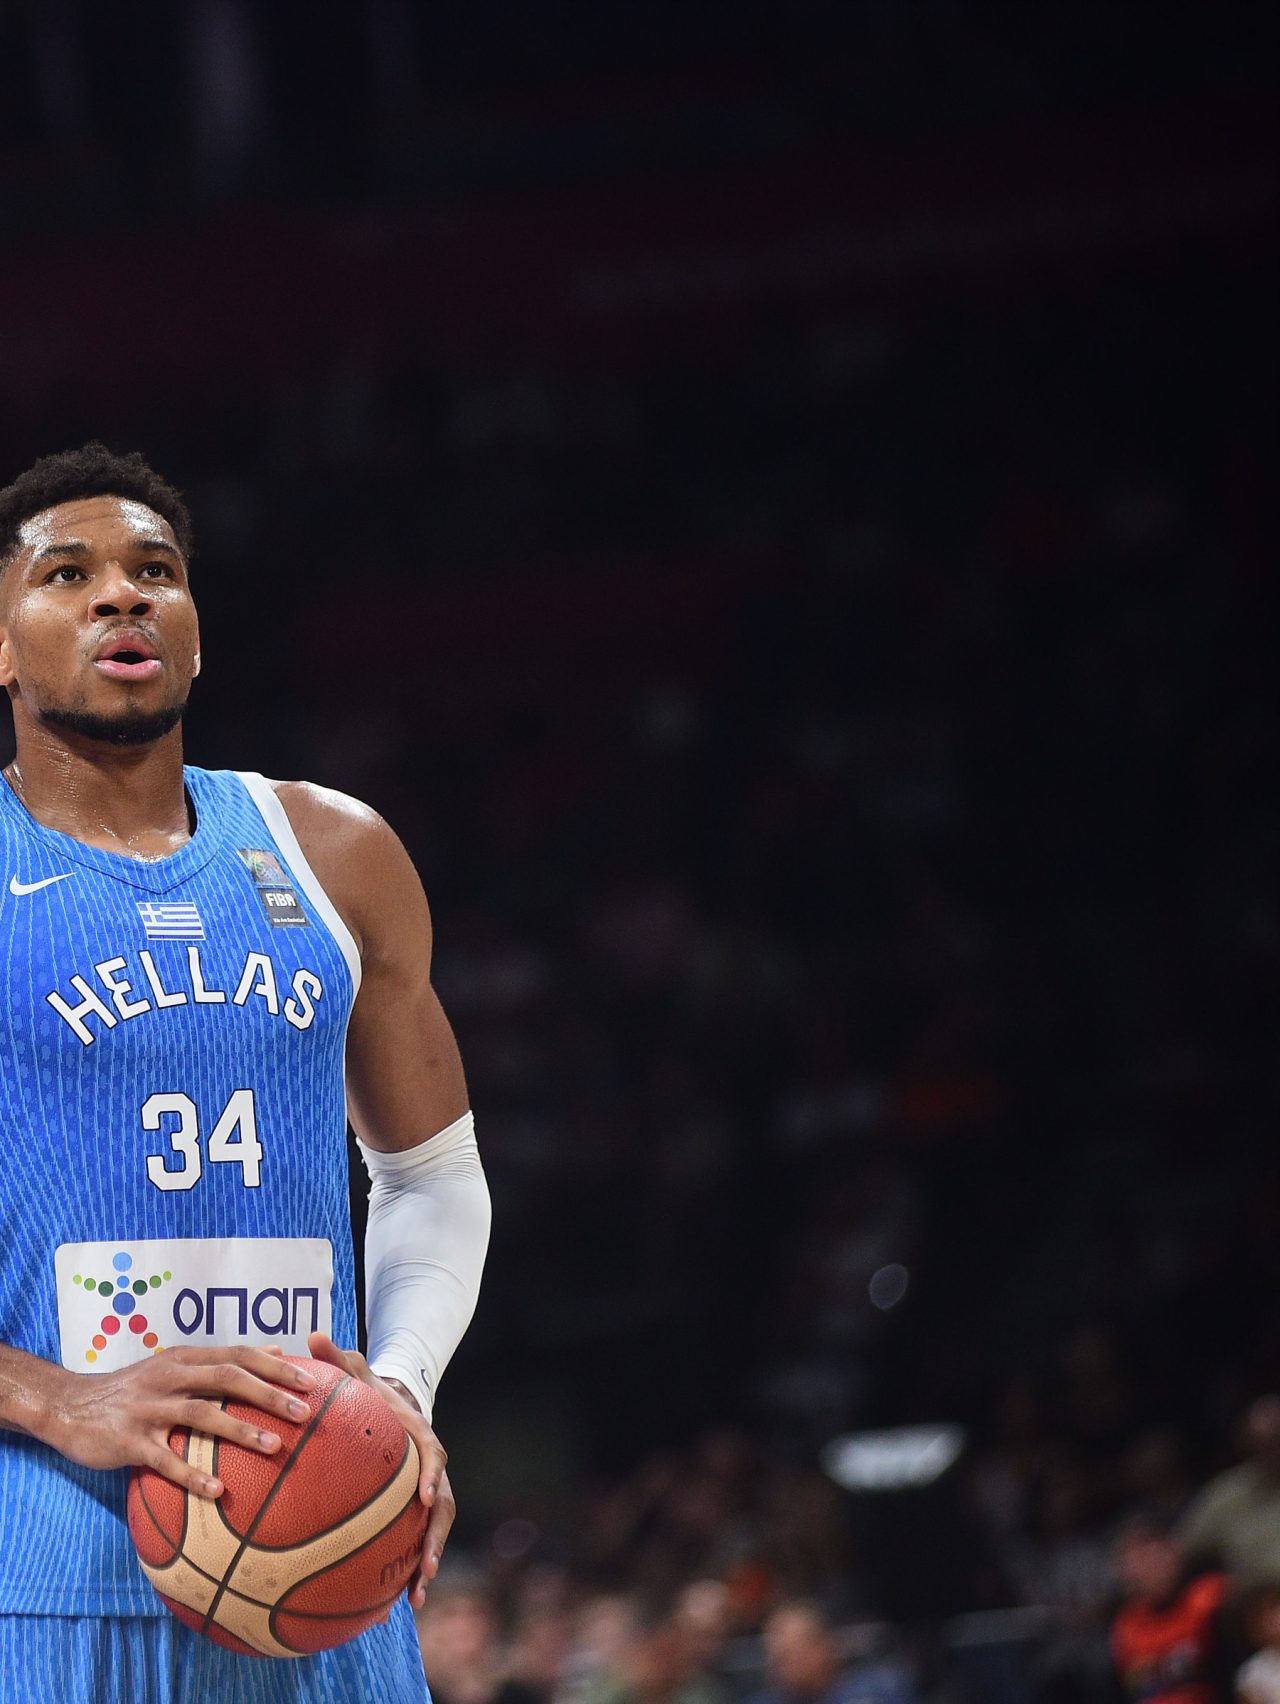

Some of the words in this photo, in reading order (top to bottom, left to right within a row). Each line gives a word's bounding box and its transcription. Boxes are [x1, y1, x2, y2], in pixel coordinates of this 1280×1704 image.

[265, 893, 296, 906] FIBA
[46, 946, 322, 1046] HELLAS
[141, 1088, 263, 1192] 34
